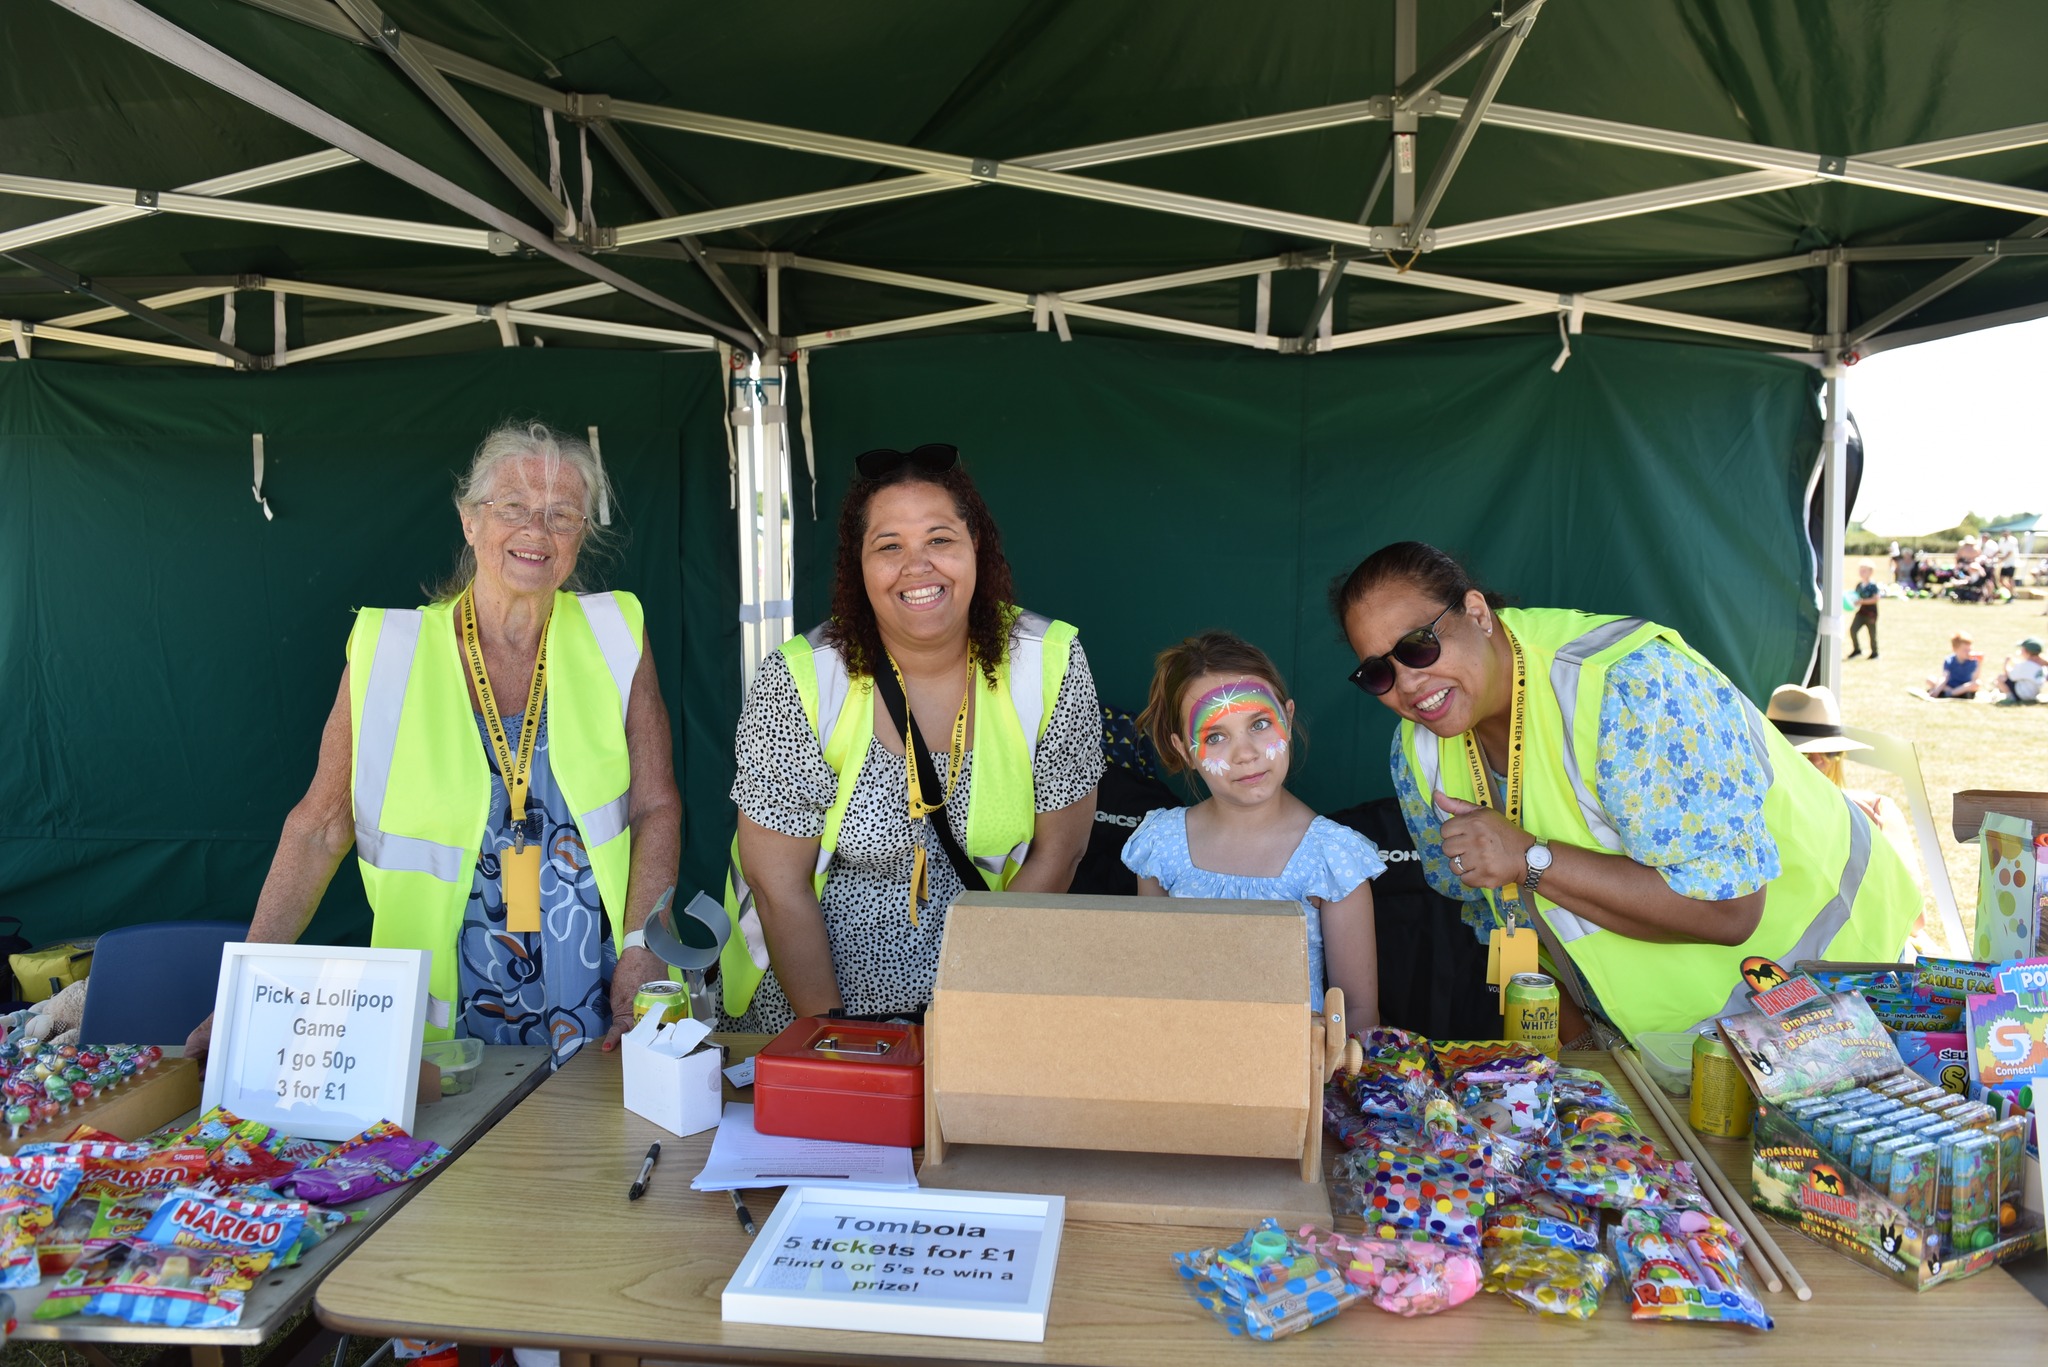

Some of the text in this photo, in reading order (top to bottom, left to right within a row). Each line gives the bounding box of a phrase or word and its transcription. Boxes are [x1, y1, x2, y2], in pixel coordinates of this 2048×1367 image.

[467, 631, 483, 676] VOLUNTEER
[1510, 630, 1525, 677] OLUNTEER
[529, 672, 543, 717] VOLUNTEER
[481, 687, 500, 734] VOLUNTEER
[1515, 690, 1525, 741] VOLUNTEER
[518, 728, 533, 775] VOLUNTEER
[906, 736, 916, 783] VOLUNTEER
[953, 723, 963, 768] VOLUNTEER
[498, 745, 514, 789] VOLUNTEE
[1468, 748, 1485, 797] VOLUNTEER
[1511, 754, 1520, 805] VOLUNTEER
[1919, 972, 1997, 994] SMILE FAC
[2021, 971, 2048, 988] PO
[255, 985, 393, 1013] Pick a Lollipop
[1753, 977, 1819, 1017] DINOSAURS
[293, 1018, 346, 1037] Game
[1780, 1008, 1834, 1032] Dinosaur
[1785, 1020, 1856, 1050] Water Game
[277, 1048, 356, 1074] 1 go 50p
[1759, 1061, 1771, 1075] 3
[1995, 1064, 2037, 1077] Connect!
[277, 1079, 346, 1101] 3 for £1
[1760, 1147, 1819, 1160] ROARSOME
[1780, 1161, 1804, 1171] FUN!
[1802, 1185, 1858, 1219] DINOSAURS
[172, 1199, 282, 1245] HARIBO
[834, 1215, 987, 1239] Tombola
[1806, 1212, 1858, 1238] Dinosaur
[783, 1236, 1016, 1262] 5 tickets for £1
[1800, 1222, 1832, 1238] Water
[1835, 1233, 1868, 1255] Game
[1883, 1236, 1895, 1252] 3
[772, 1256, 1014, 1281] Find 0 or 5's to win a
[852, 1279, 920, 1293] prize!
[1634, 1282, 1764, 1317] Rainbow
